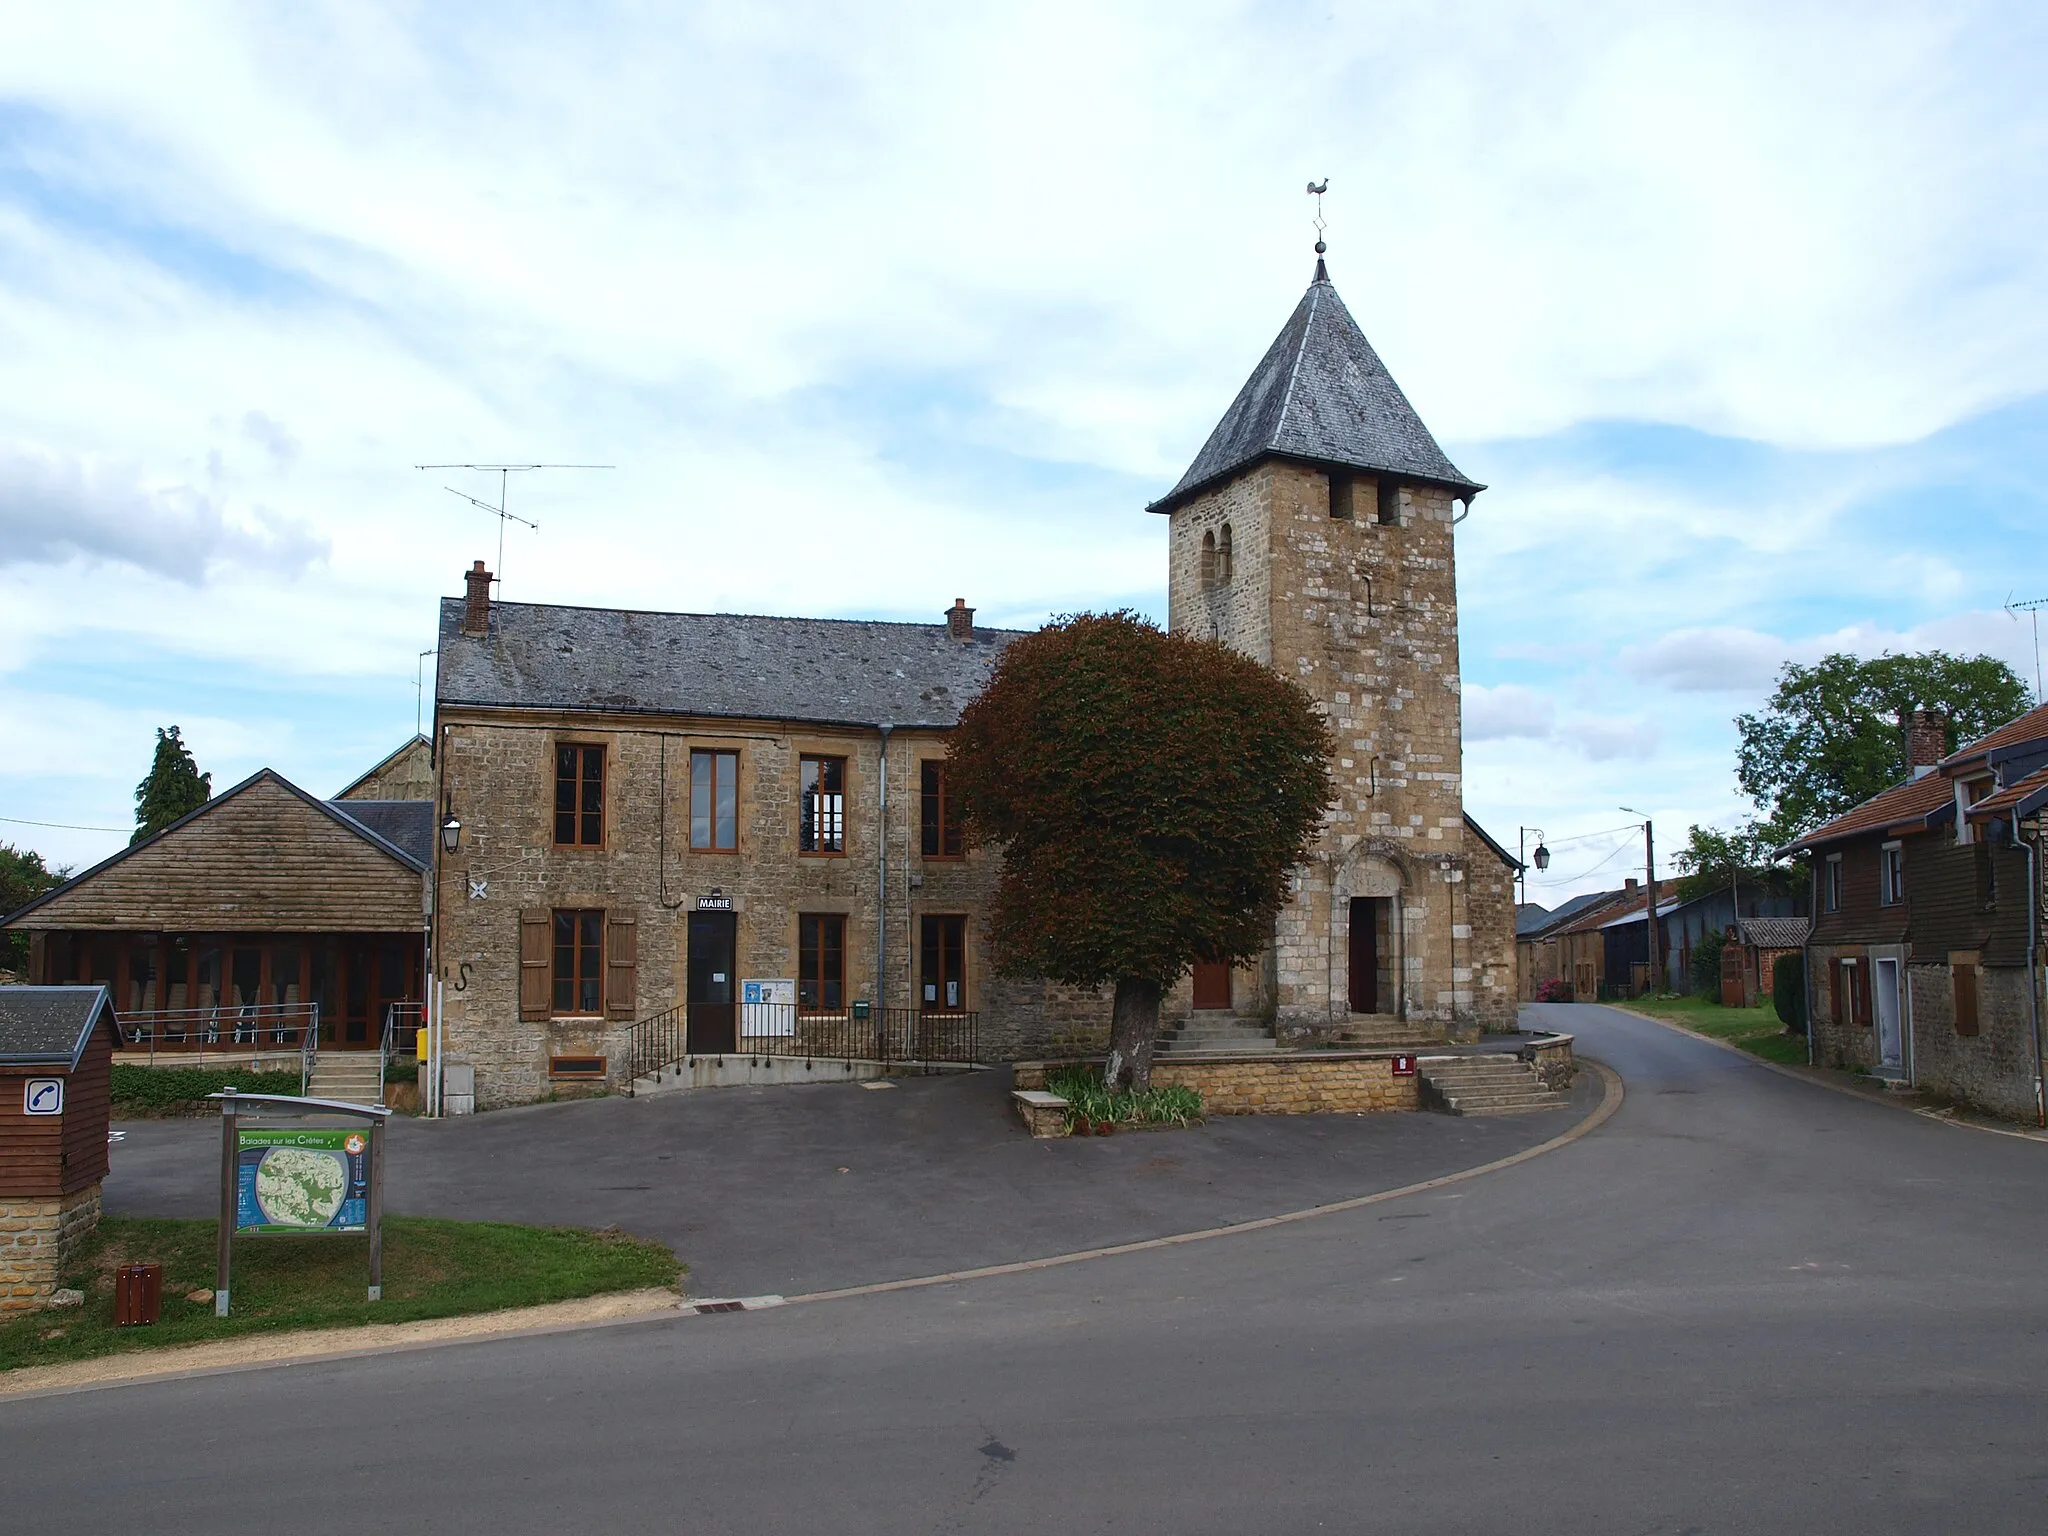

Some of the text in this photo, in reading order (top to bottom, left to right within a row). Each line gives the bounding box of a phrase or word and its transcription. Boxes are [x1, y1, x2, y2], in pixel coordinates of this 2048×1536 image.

[700, 899, 730, 908] MAIRIE
[239, 1135, 271, 1145] Balades
[285, 1137, 296, 1145] les
[297, 1135, 324, 1145] Crêtes
